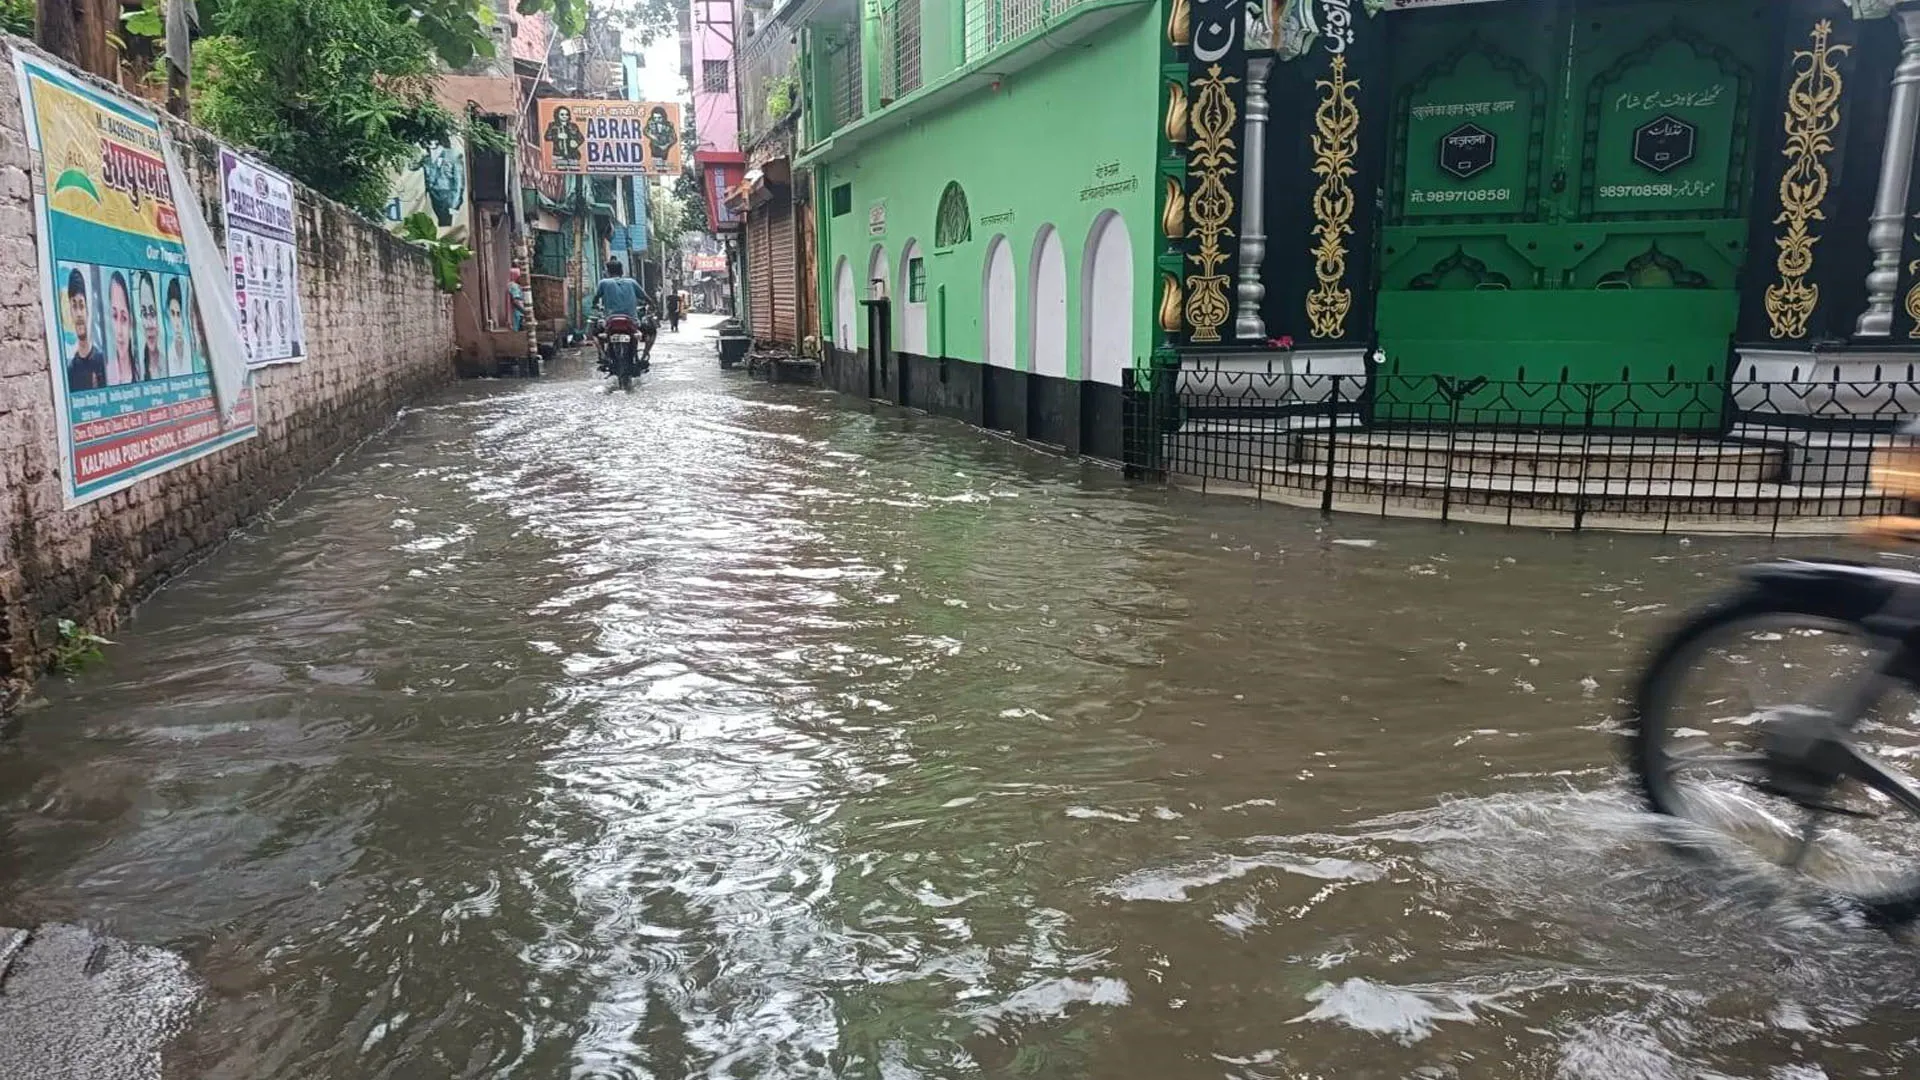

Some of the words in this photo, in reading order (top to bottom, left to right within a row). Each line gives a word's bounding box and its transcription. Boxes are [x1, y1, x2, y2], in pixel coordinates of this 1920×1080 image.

[587, 118, 642, 139] ABRAR
[587, 141, 644, 163] BAND
[1426, 188, 1510, 202] 9897108581
[1599, 184, 1673, 198] 9897108581
[81, 449, 123, 476] KALPANA
[122, 439, 150, 464] PUBLIC
